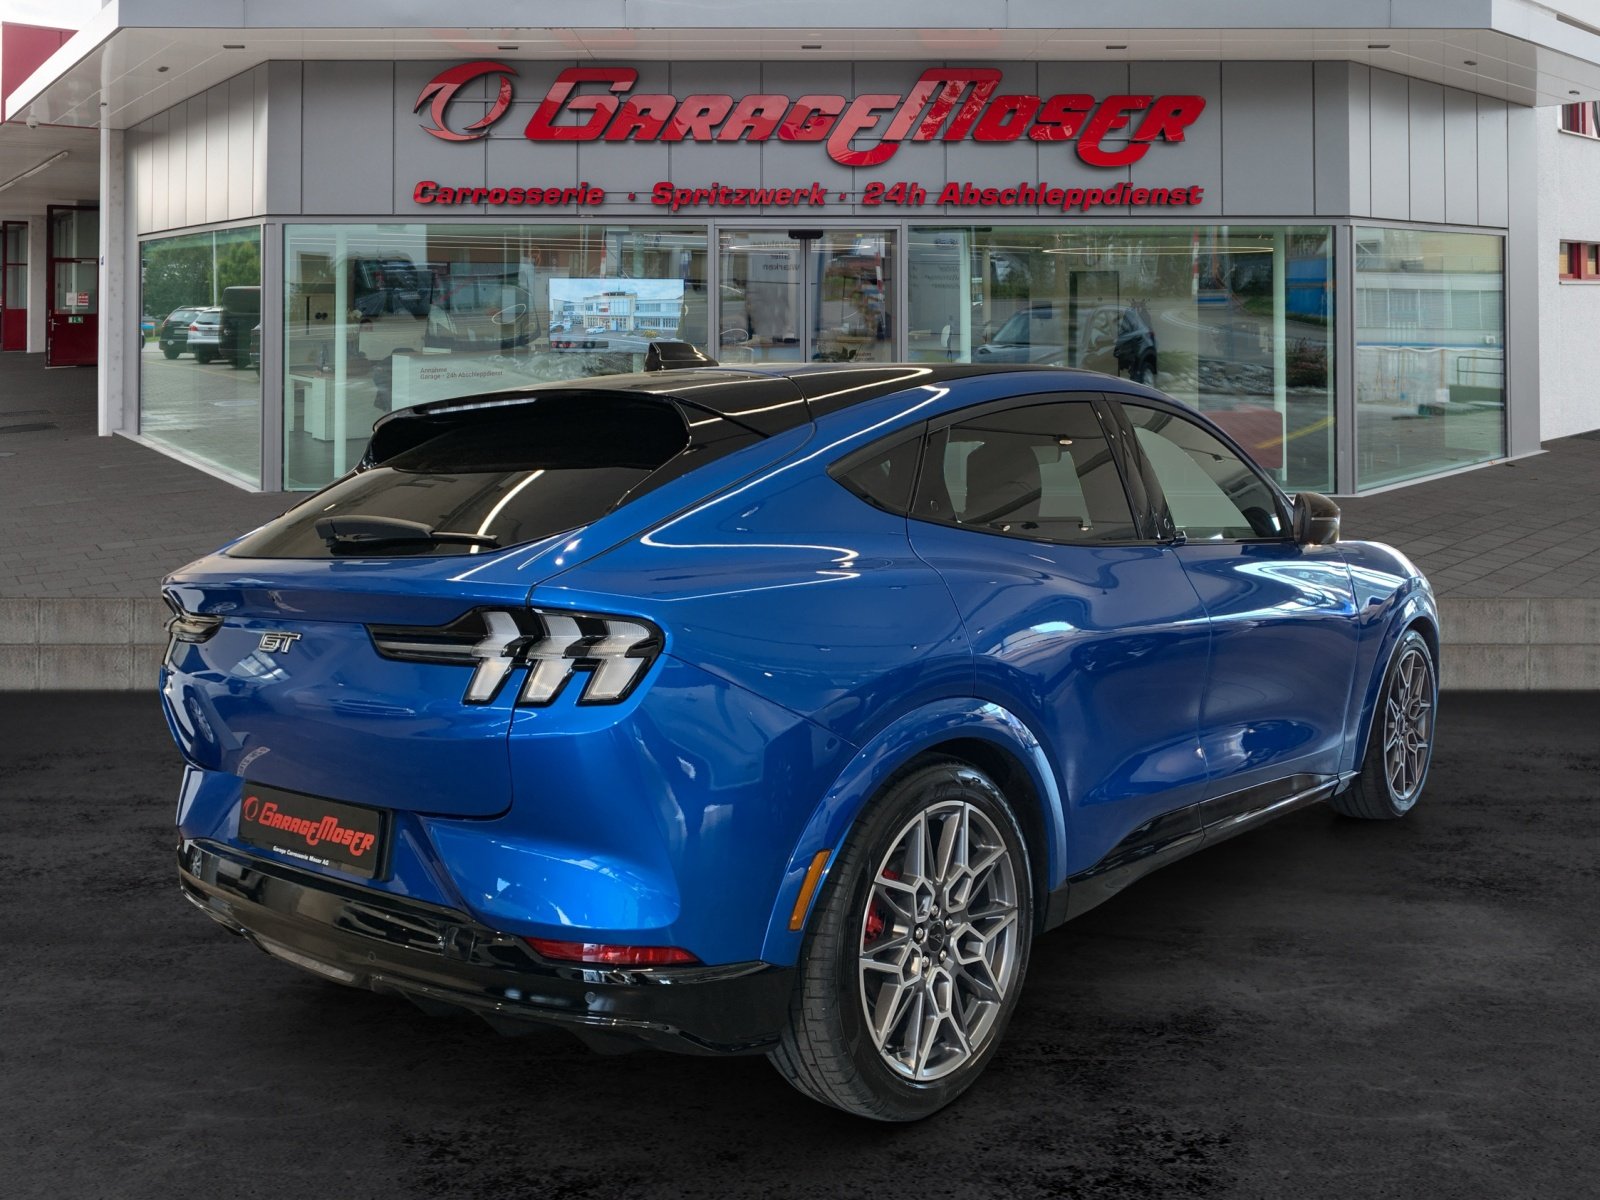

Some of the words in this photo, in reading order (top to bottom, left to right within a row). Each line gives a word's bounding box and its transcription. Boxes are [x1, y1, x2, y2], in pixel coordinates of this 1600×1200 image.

[413, 181, 605, 206] Carrosserie
[651, 182, 827, 211] Spritzwerk
[863, 182, 927, 206] 24h
[937, 182, 1204, 212] Abschleppdienst
[258, 631, 302, 654] GT
